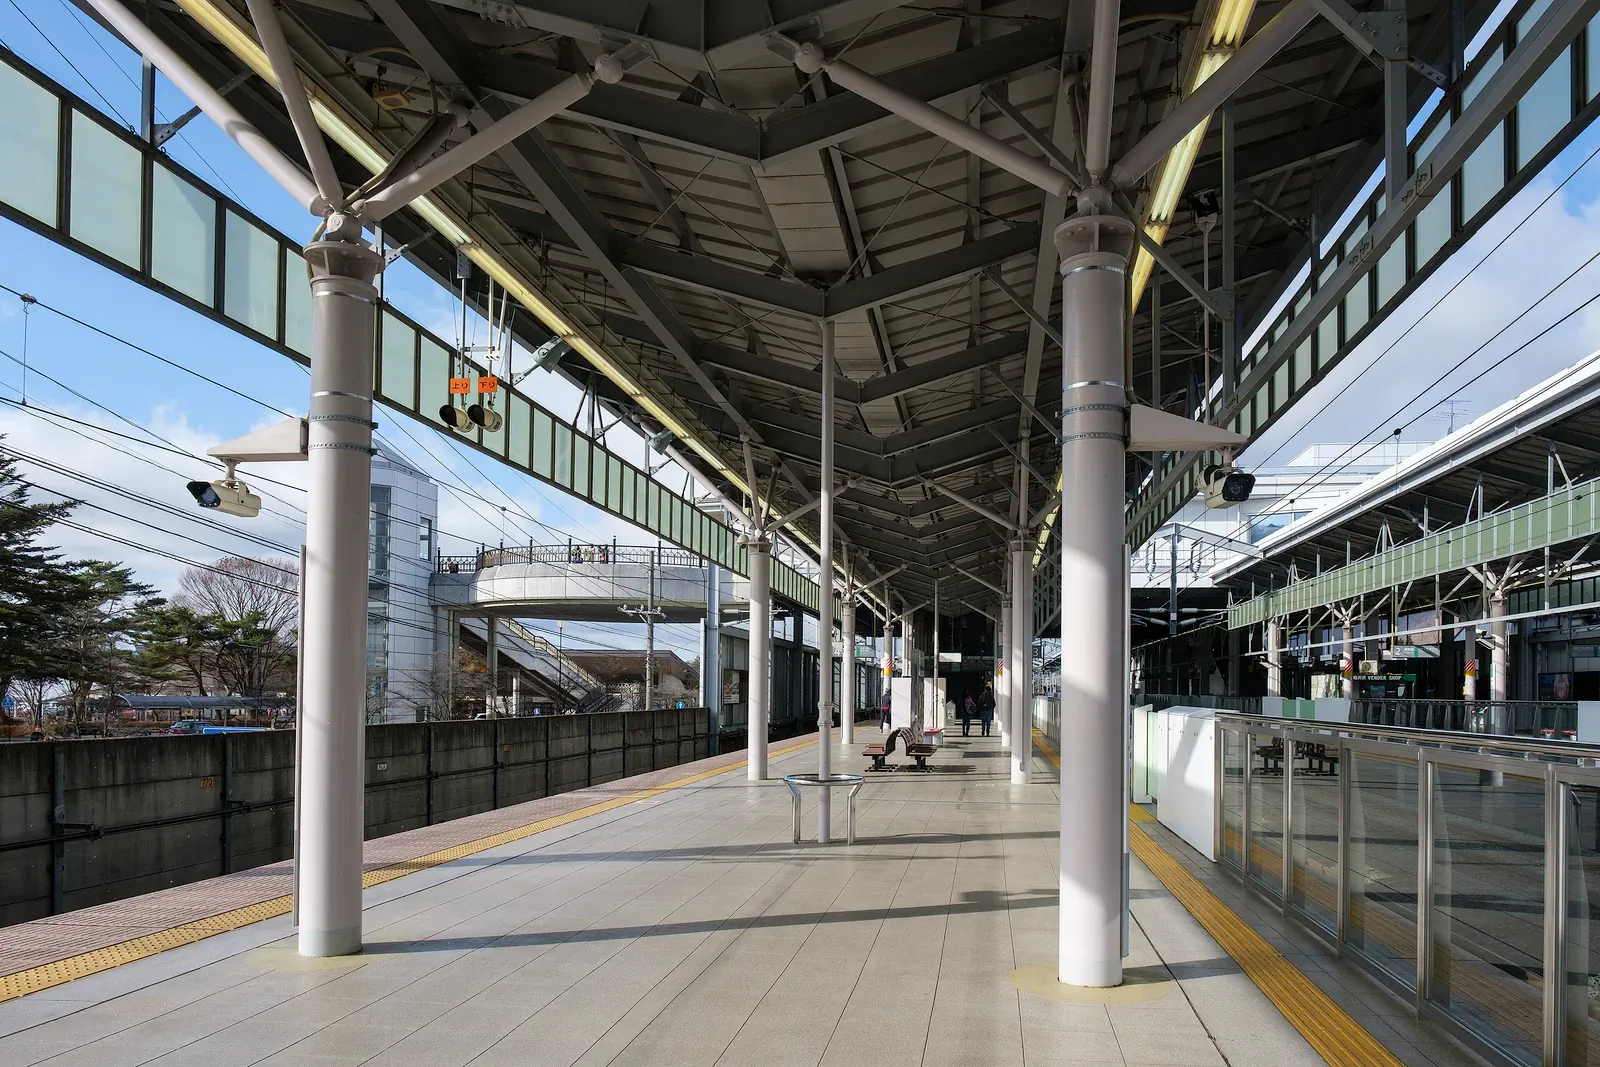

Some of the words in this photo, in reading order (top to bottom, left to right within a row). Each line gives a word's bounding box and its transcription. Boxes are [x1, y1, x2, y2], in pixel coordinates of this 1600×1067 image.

[451, 382, 469, 390] 上り
[479, 381, 495, 389] 下り
[1032, 647, 1039, 657] 3
[1395, 647, 1401, 656] 2
